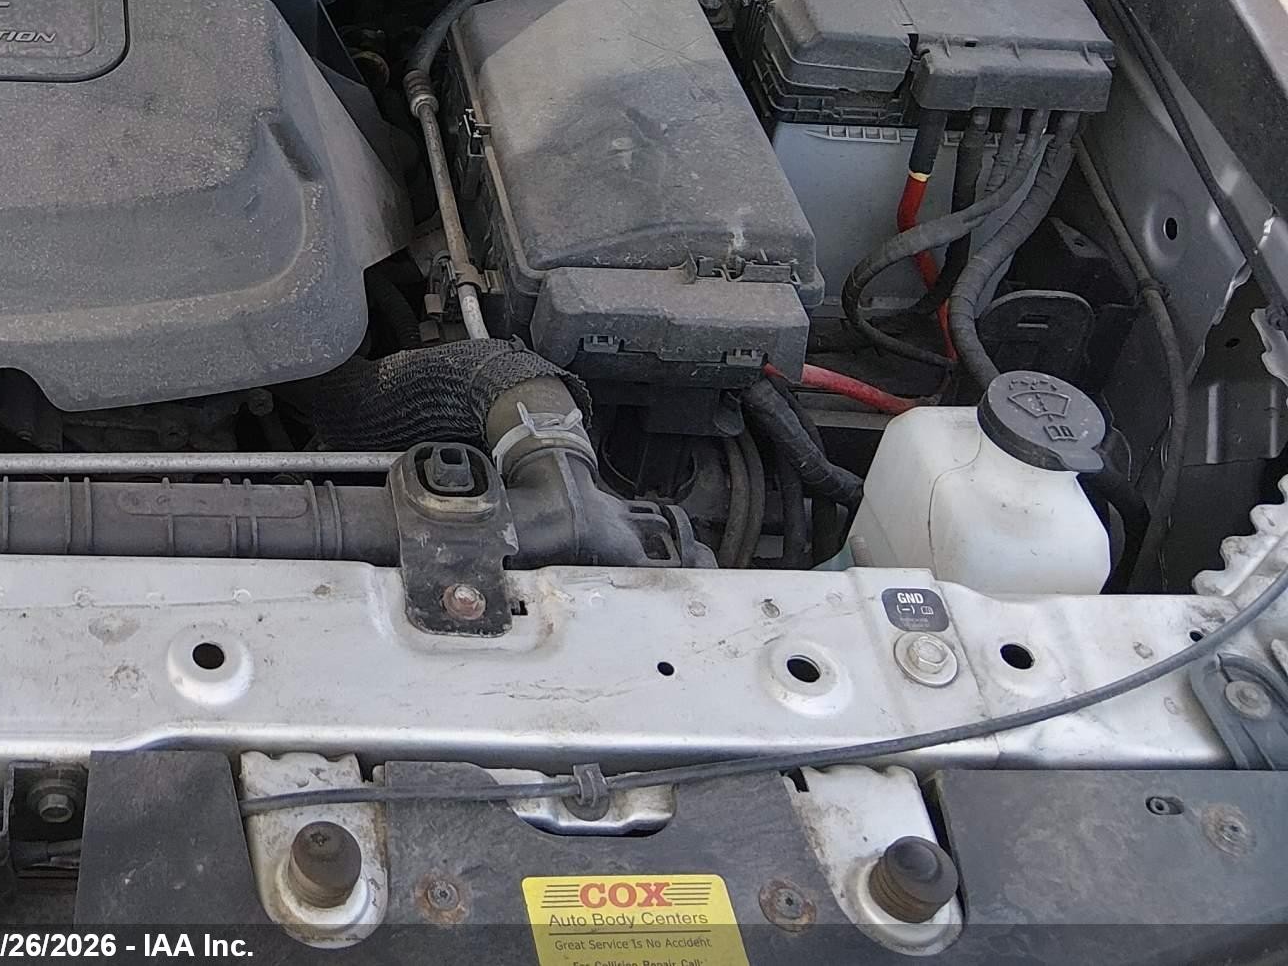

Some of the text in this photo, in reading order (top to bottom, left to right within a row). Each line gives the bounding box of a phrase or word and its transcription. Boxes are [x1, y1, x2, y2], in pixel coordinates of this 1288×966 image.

[897, 592, 924, 604] GND
[579, 882, 673, 909] COX
[549, 912, 709, 929] Auto Body Centers
[555, 940, 585, 951] Great
[589, 939, 629, 950] Service
[632, 938, 643, 949] Is
[646, 938, 662, 948] No
